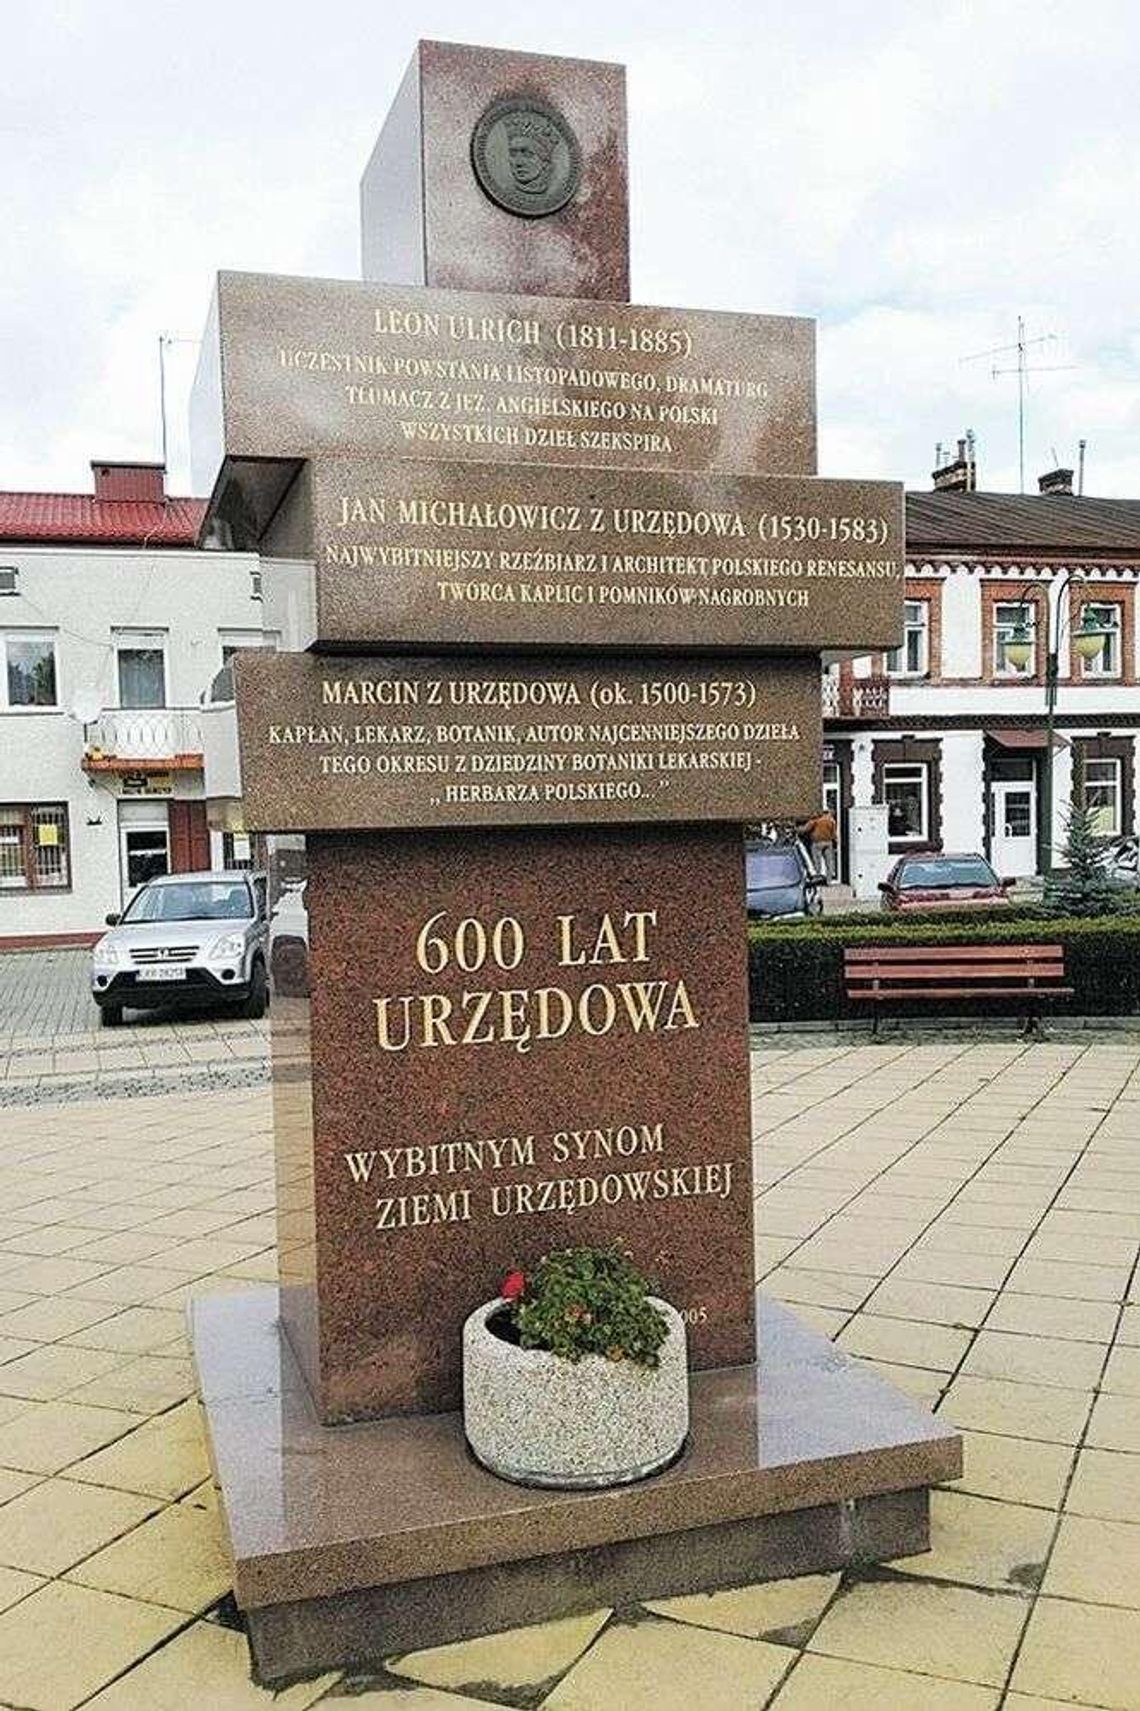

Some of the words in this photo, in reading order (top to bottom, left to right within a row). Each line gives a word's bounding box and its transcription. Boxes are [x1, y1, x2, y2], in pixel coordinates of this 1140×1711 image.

[374, 309, 441, 336] LEON
[449, 315, 541, 343] ULRICH
[556, 324, 693, 357] (1811-1885)
[394, 358, 502, 382] POWSTANIA
[667, 376, 768, 399] DRAMATURG
[495, 396, 626, 420] ANGIELSKIEGO
[631, 403, 655, 422] NA
[659, 405, 718, 425] POLSKI
[400, 421, 519, 445] WSZYSTKICH
[525, 427, 577, 447] DZIEŁ
[581, 432, 673, 453] SZEKSPIRA
[337, 497, 387, 526] JAN
[399, 500, 581, 532] MICHAŁOWICZ
[590, 508, 605, 533] Z
[614, 509, 747, 538] URZĘDOWA
[758, 513, 889, 546] (1530-1583)
[326, 545, 495, 571] NAJWYBITNIEJSZY
[500, 548, 597, 572] RZEŹBIARZ
[600, 555, 608, 573] I
[613, 556, 707, 577] ARCHITEKT
[712, 558, 802, 577] POLSKIEGO
[437, 580, 515, 602] TWÓRCA
[521, 584, 585, 603] KAPLIC
[588, 586, 595, 603] I
[600, 584, 695, 605] POMNIKÓW
[700, 587, 810, 607] NAGROBNYCH
[321, 680, 420, 704] MARCIN
[427, 681, 443, 704] Z
[449, 681, 581, 709] URZĘDOWA
[590, 681, 633, 709] (ok.
[640, 680, 756, 709] 1500-1573)
[268, 726, 349, 746] KAPŁAN,
[355, 726, 431, 746] LEKARZ,
[437, 725, 522, 745] BOTANIK,
[526, 725, 585, 742] AUTOR
[589, 724, 739, 745] NAJCENNIEJSZEGO
[744, 723, 801, 741] DZIEŁA
[319, 756, 371, 774] TEGO
[377, 755, 449, 773] OKRESU
[455, 755, 467, 773] Z
[471, 753, 571, 773] DZIEDZINY
[572, 753, 654, 772] BOTANIKI
[658, 751, 751, 773] LEKARSKIEJ
[416, 910, 525, 974] 600
[557, 911, 657, 967] LAT
[373, 980, 700, 1053] URZĘDOWA
[345, 1134, 535, 1183] WYBITNYM
[553, 1123, 665, 1163] SYNOM
[376, 1190, 471, 1231] ZIEMI
[491, 1162, 734, 1217] URZĘDOWSKIEJ
